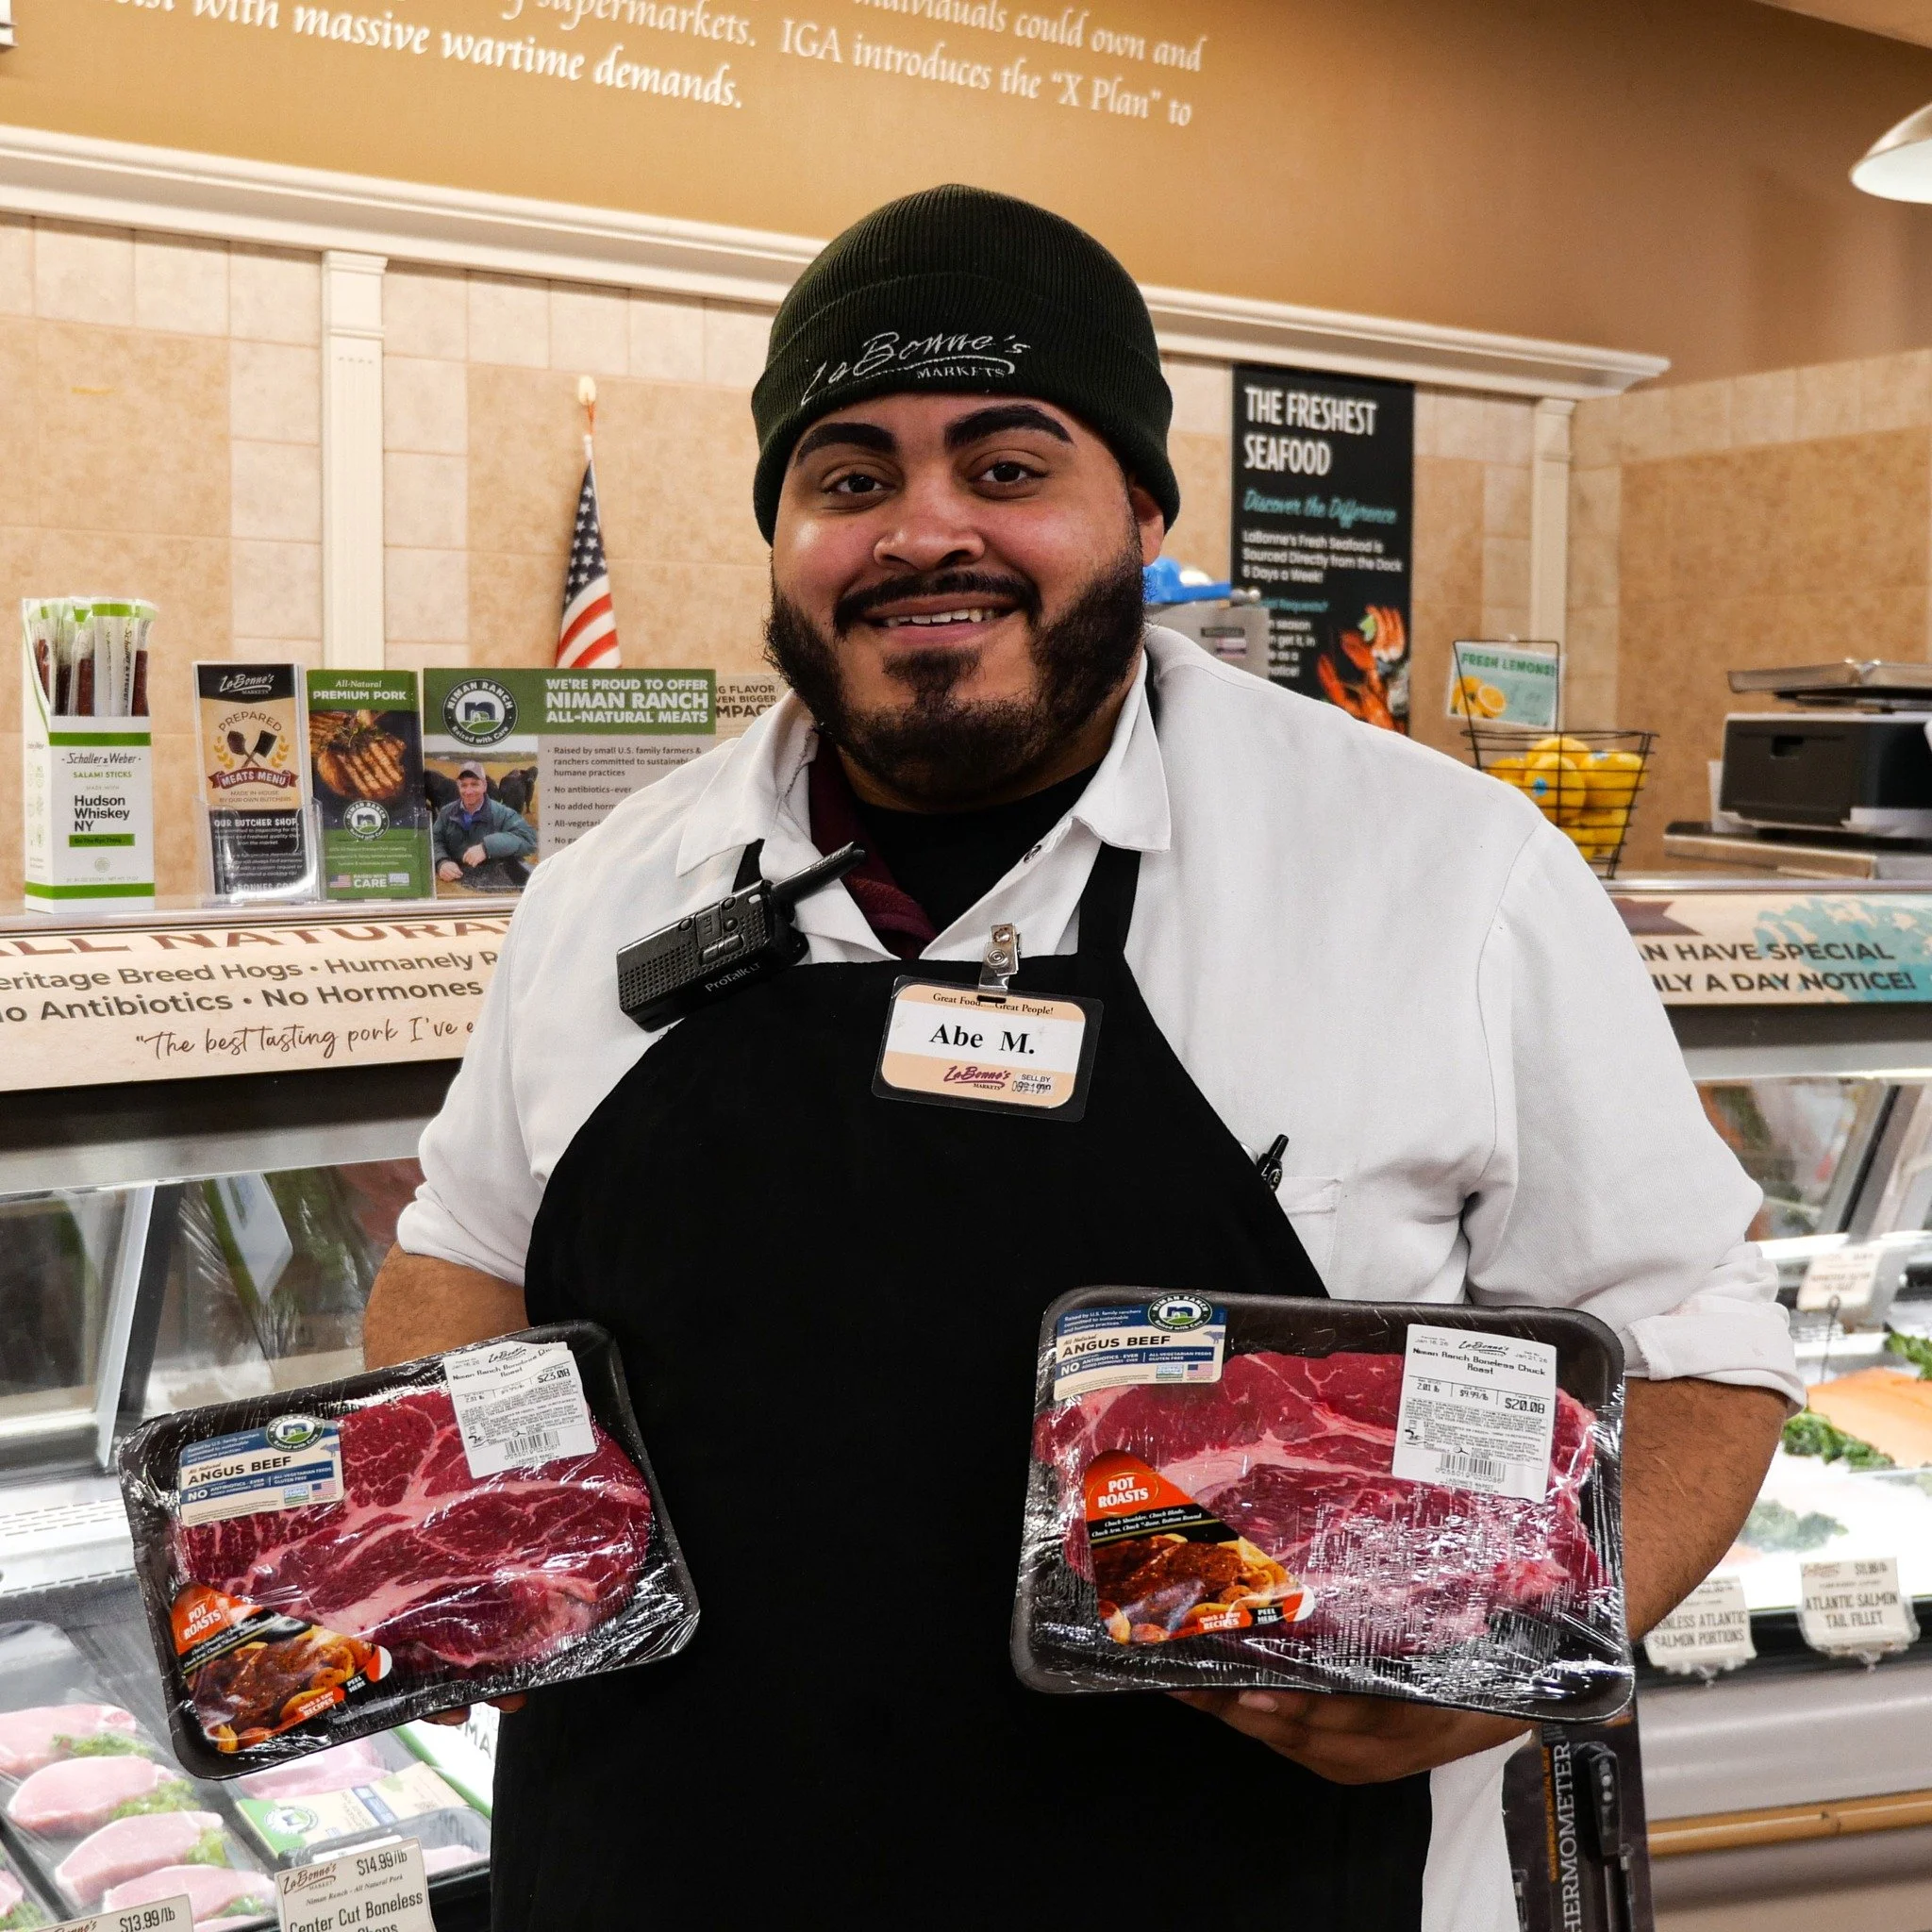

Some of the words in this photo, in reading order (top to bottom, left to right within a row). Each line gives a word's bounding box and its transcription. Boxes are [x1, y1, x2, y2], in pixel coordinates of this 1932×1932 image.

[853, 0, 1008, 33] ividuals
[1014, 8, 1090, 48] could
[1091, 26, 1145, 60] own
[1152, 36, 1208, 72] and
[192, 0, 280, 29] with
[292, 6, 430, 55] massive
[441, 29, 585, 81] wartime
[591, 43, 742, 108] demands.
[782, 19, 843, 63] IGA
[853, 34, 991, 91] introduces
[1001, 57, 1041, 99] the
[1168, 98, 1192, 126] to
[916, 365, 1006, 378] MARKETS
[1243, 386, 1283, 425] THE
[1286, 391, 1378, 436] FRESHEST
[1243, 432, 1333, 476] SEAFOOD
[1304, 493, 1325, 518] the
[1298, 535, 1327, 549] Fresh
[1373, 540, 1385, 554] is
[1241, 547, 1288, 562] Sourced
[1289, 551, 1329, 569] Directly
[1329, 555, 1356, 568] from
[1357, 556, 1374, 570] the
[1251, 565, 1279, 582] Days
[1290, 568, 1324, 583] Week
[1461, 652, 1499, 669] FRESH
[219, 674, 275, 692] LaBonne's
[335, 679, 382, 689] All-Natural
[546, 678, 588, 691] WE'RE
[592, 678, 641, 691] PROUD
[645, 679, 663, 690] TO
[667, 679, 708, 691] OFFER
[729, 685, 775, 693] FLAVOR
[312, 691, 370, 700] PREMIUM
[374, 691, 407, 700] PORK
[447, 682, 477, 709] NIMAN
[482, 682, 514, 709] RANCH
[546, 692, 625, 708] NIMAN
[632, 692, 708, 708] RANCH
[740, 694, 776, 703] BIGGER
[218, 710, 282, 733] PREPARED
[546, 710, 654, 723] ALL-NATURAL
[658, 711, 708, 724] MEATS
[452, 725, 475, 742] Raised
[493, 726, 508, 739] Care
[67, 752, 103, 764] Schaller
[109, 752, 137, 764] Weber
[582, 747, 592, 756] by
[636, 747, 660, 756] family
[222, 771, 255, 787] MEATS
[258, 771, 286, 785] MENU
[589, 769, 625, 777] practices
[75, 794, 125, 807] Hudson
[75, 808, 130, 821] Whiskey
[366, 803, 386, 819] RANCH
[75, 821, 94, 832] NY
[214, 819, 232, 827] OUR
[235, 819, 273, 827] BUTCHER
[354, 878, 387, 888] CARE
[148, 920, 510, 950] NATURA
[1672, 943, 1759, 961] HAVE
[1765, 942, 1896, 961] SPECIAL
[117, 964, 215, 985] Breed
[221, 960, 303, 982] Hogs
[325, 952, 474, 974] Humanely
[705, 968, 751, 992] ProTalk
[1706, 973, 1728, 991] A
[1731, 973, 1790, 991] DAY
[1794, 972, 1918, 992] NOTICE!
[41, 991, 234, 1021] Antibiotics
[261, 988, 309, 1008] No
[316, 980, 485, 1005] Hormones
[933, 992, 958, 1005] Great
[995, 1002, 1019, 1012] Great
[1022, 1004, 1054, 1016] People!
[206, 1027, 251, 1056] best
[253, 1023, 338, 1059] tasting
[347, 1018, 398, 1052] pork
[409, 1016, 458, 1043] I've
[929, 1024, 984, 1048] Abe
[998, 1030, 1035, 1055] M.
[943, 1065, 1011, 1082] LaBonne's
[1021, 1074, 1039, 1082] SELL
[1153, 1295, 1180, 1311] NIMAN
[1183, 1295, 1210, 1311] RANCH
[1062, 1338, 1120, 1358] ANGUS
[1126, 1335, 1171, 1346] BEEF
[1060, 1362, 1080, 1376] NO
[1082, 1355, 1120, 1364] ANTIBIOTICS
[1412, 1347, 1439, 1357] Niman
[1441, 1351, 1470, 1362] Ranch
[1473, 1356, 1515, 1370] Boneless
[1518, 1363, 1546, 1375] Chuck
[1467, 1362, 1493, 1375] Roast
[537, 1368, 571, 1384] $23.08
[1505, 1397, 1545, 1414] $20.08
[188, 1464, 244, 1486] ANGUS
[251, 1456, 291, 1472] BEEF
[1108, 1476, 1135, 1492] POT
[188, 1489, 208, 1502] NO
[1097, 1488, 1149, 1508] ROASTS
[1105, 1519, 1122, 1527] Chuck
[1091, 1529, 1108, 1538] Chuck
[1805, 1593, 1853, 1611] ATLANTIC
[1857, 1591, 1898, 1607] SALMON
[189, 1603, 207, 1623] POT
[1257, 1607, 1276, 1616] PEEL
[1257, 1614, 1278, 1623] HERE
[1699, 1609, 1747, 1627] ATLANTIC
[1850, 1610, 1884, 1628] FILLET
[183, 1608, 222, 1641] ROASTS
[1203, 1618, 1240, 1630] RECIPES
[1653, 1631, 1696, 1648] SALMON
[1699, 1628, 1744, 1646] PORTIONS
[346, 1675, 363, 1687] PEEL
[348, 1679, 367, 1693] HERE
[304, 1698, 335, 1717] RECIPES
[283, 1862, 337, 1895] LaBonne's
[357, 1850, 408, 1877] $14.99/lb
[306, 1895, 327, 1906] Niman
[328, 1890, 349, 1900] Ranch
[365, 1878, 388, 1890] Natural
[389, 1874, 404, 1883] Pork
[119, 1907, 175, 1932] $13.99/lb
[290, 1916, 334, 1932] Center
[339, 1907, 361, 1927] Cut
[365, 1891, 424, 1919] Boneless
